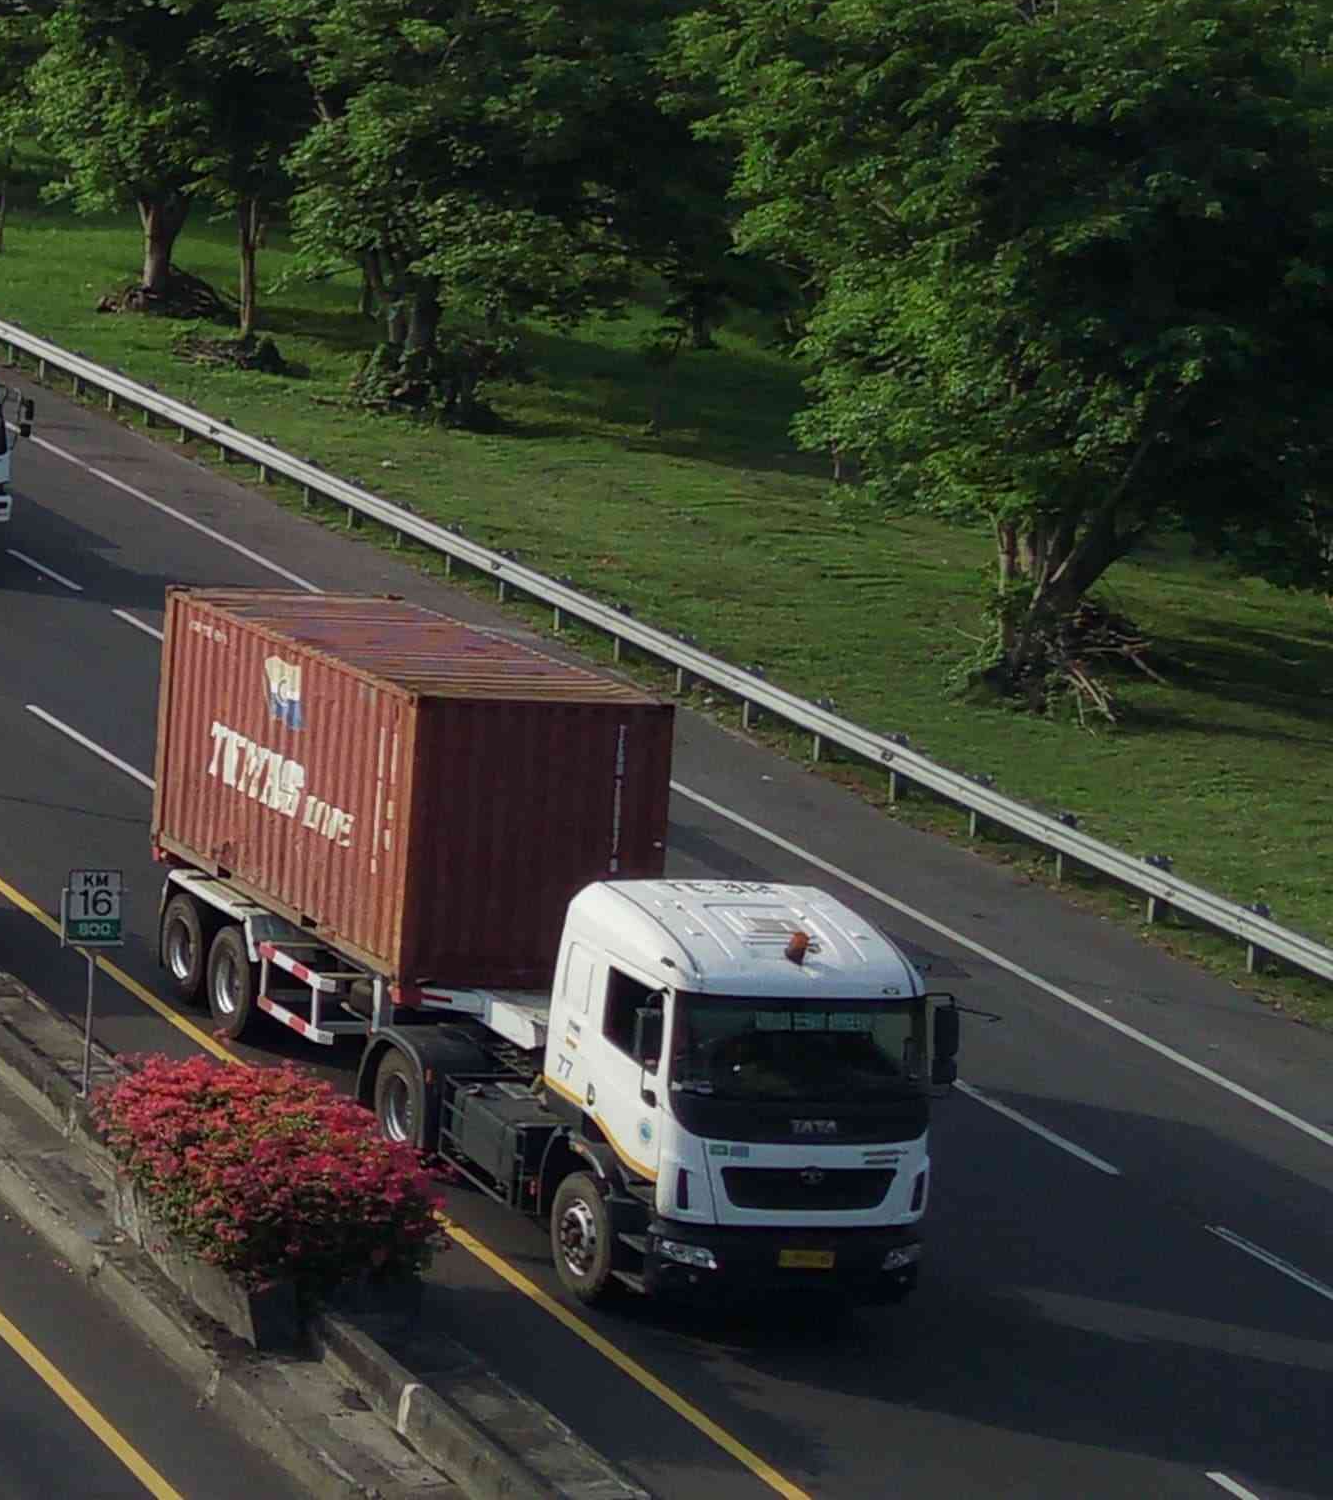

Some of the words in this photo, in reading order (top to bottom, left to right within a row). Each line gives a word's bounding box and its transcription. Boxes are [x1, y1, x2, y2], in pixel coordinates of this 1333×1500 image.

[208, 721, 304, 818] TEMAS
[301, 795, 355, 847] LINE
[83, 875, 109, 887] KM
[79, 889, 112, 916] 16
[557, 1052, 574, 1079] 77
[791, 1119, 837, 1133] TATA
